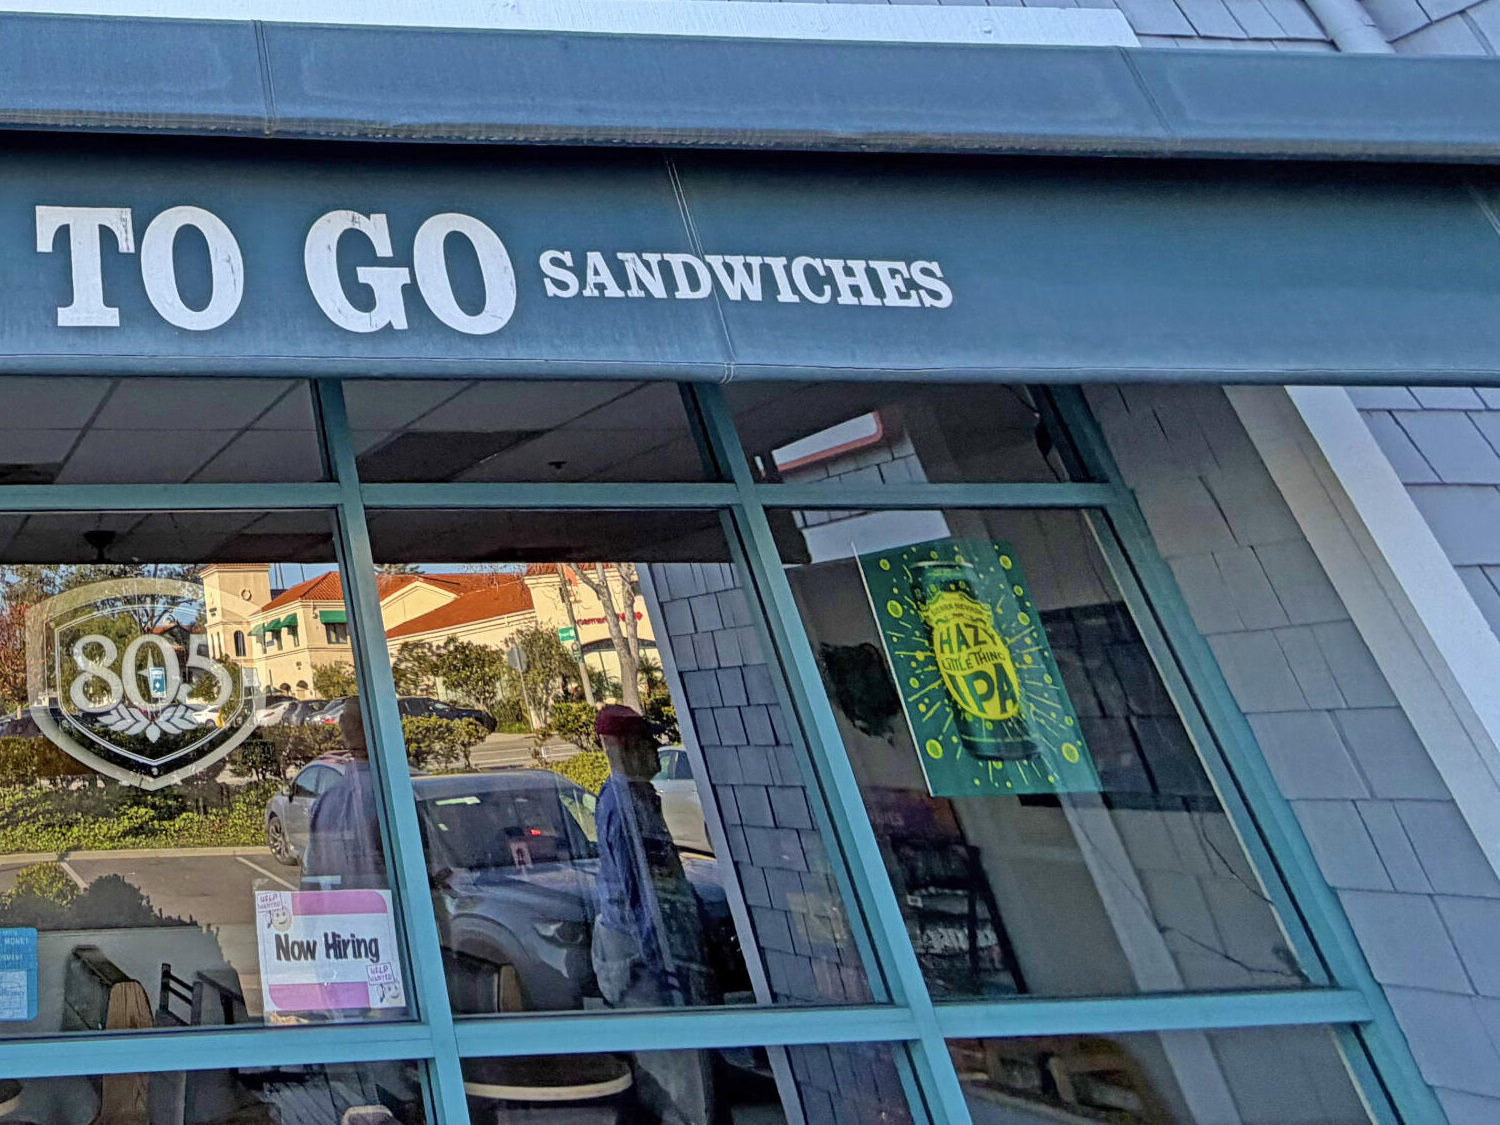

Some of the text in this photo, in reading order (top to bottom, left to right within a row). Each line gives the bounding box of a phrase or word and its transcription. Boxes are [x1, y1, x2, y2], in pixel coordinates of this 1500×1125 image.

[35, 204, 244, 331] TO
[303, 209, 518, 335] GO
[542, 248, 954, 309] SANDWICHES
[939, 622, 998, 655] HAZY
[70, 634, 233, 713] 805
[940, 647, 1006, 672] LITTLE THING
[945, 662, 1019, 716] IPA
[260, 893, 278, 903] HELP
[274, 931, 381, 964] Now Hiring
[370, 964, 389, 975] HELP
